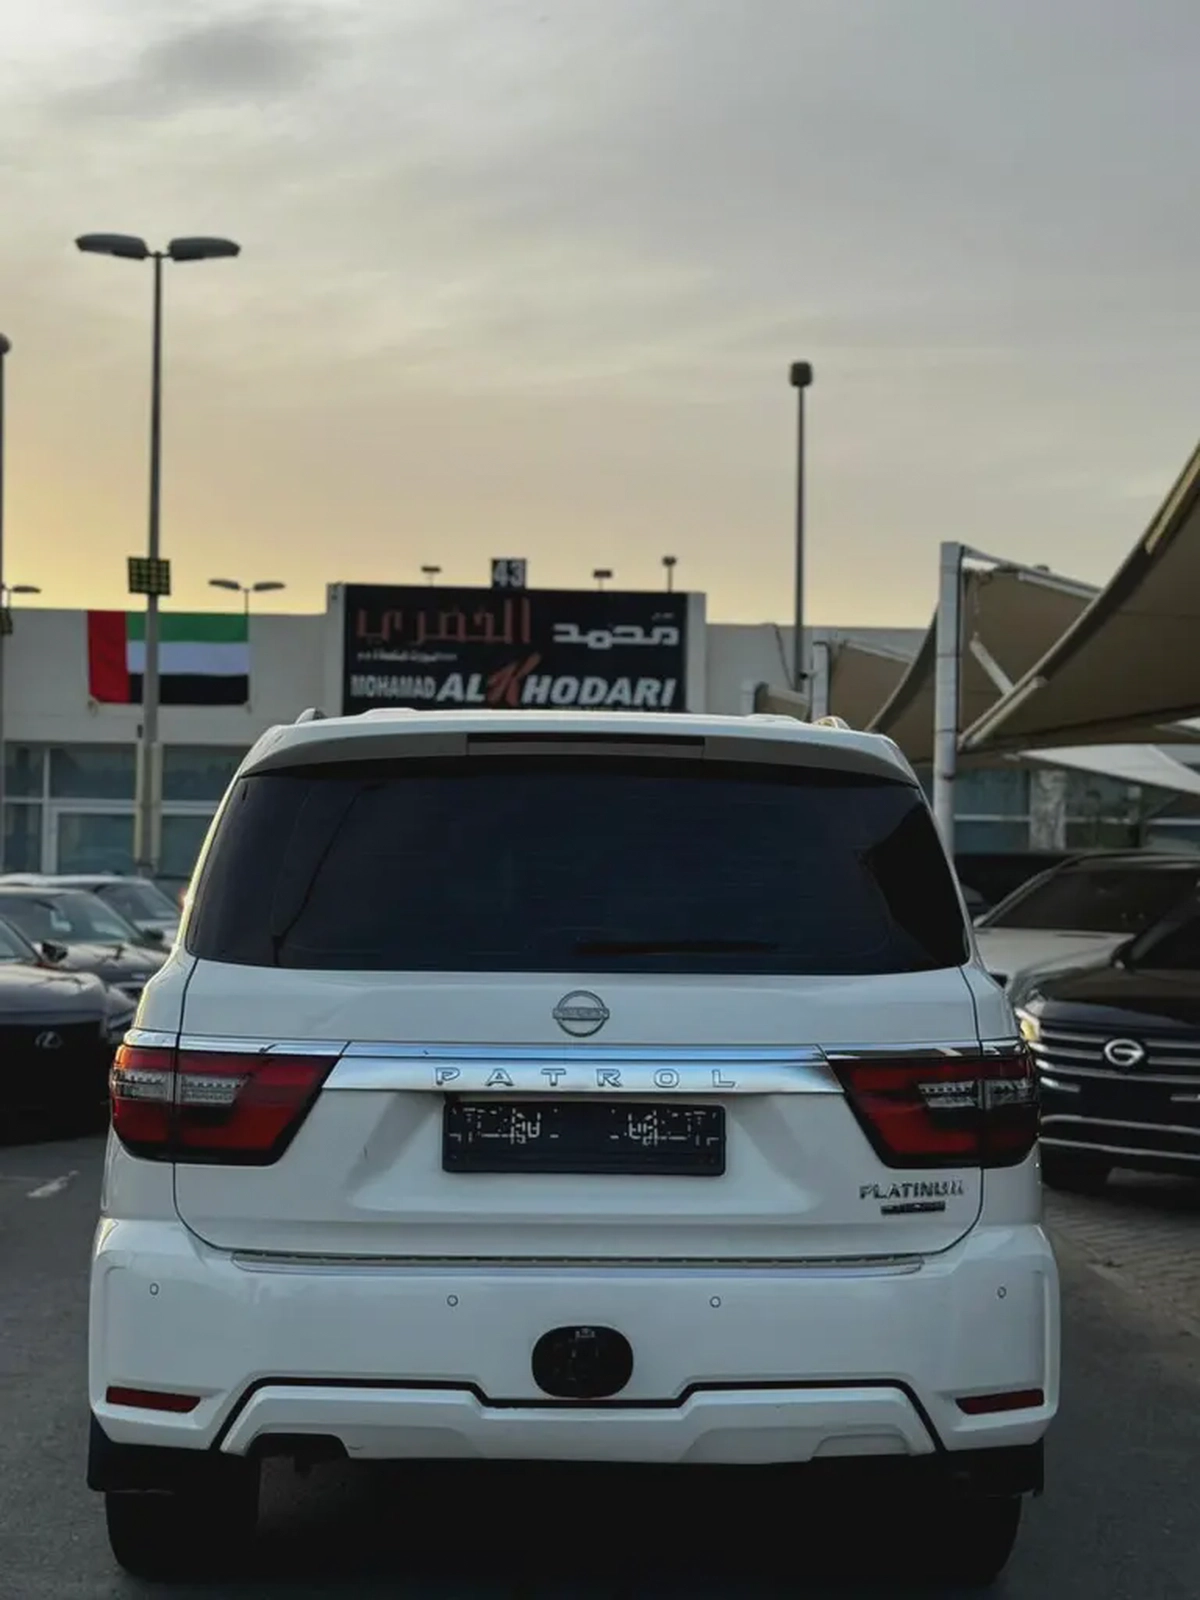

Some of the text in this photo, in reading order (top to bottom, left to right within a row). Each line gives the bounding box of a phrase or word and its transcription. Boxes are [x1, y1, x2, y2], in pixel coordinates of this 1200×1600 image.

[494, 560, 524, 587] 43
[552, 622, 680, 650] محمد
[350, 674, 437, 699] MOHAMAD
[436, 673, 486, 703] AL
[435, 1067, 736, 1089] PATROL
